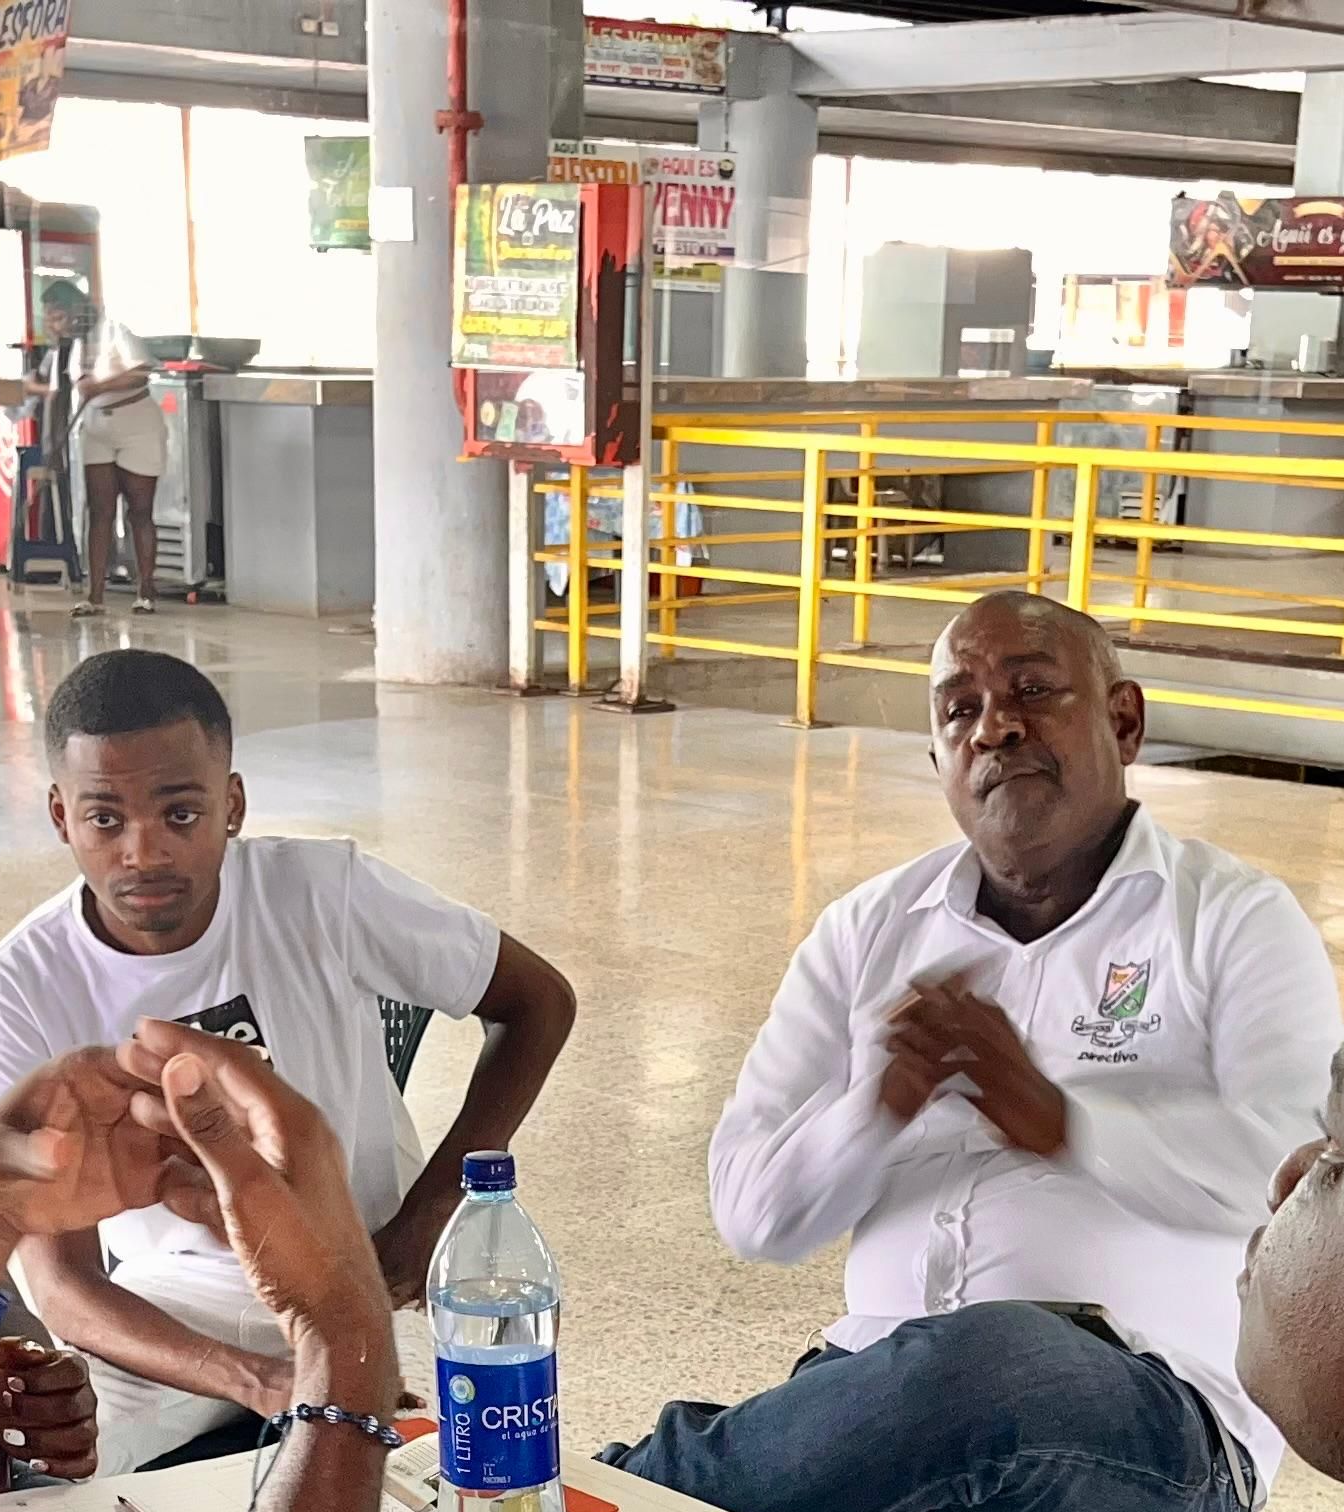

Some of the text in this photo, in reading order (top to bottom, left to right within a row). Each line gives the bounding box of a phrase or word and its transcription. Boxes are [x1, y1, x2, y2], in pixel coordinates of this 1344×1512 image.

[699, 159, 715, 178] ES
[498, 195, 576, 237] La Paz
[1077, 1049, 1139, 1064] Directivo
[455, 1412, 471, 1462] LITRO
[515, 1429, 537, 1441] agua
